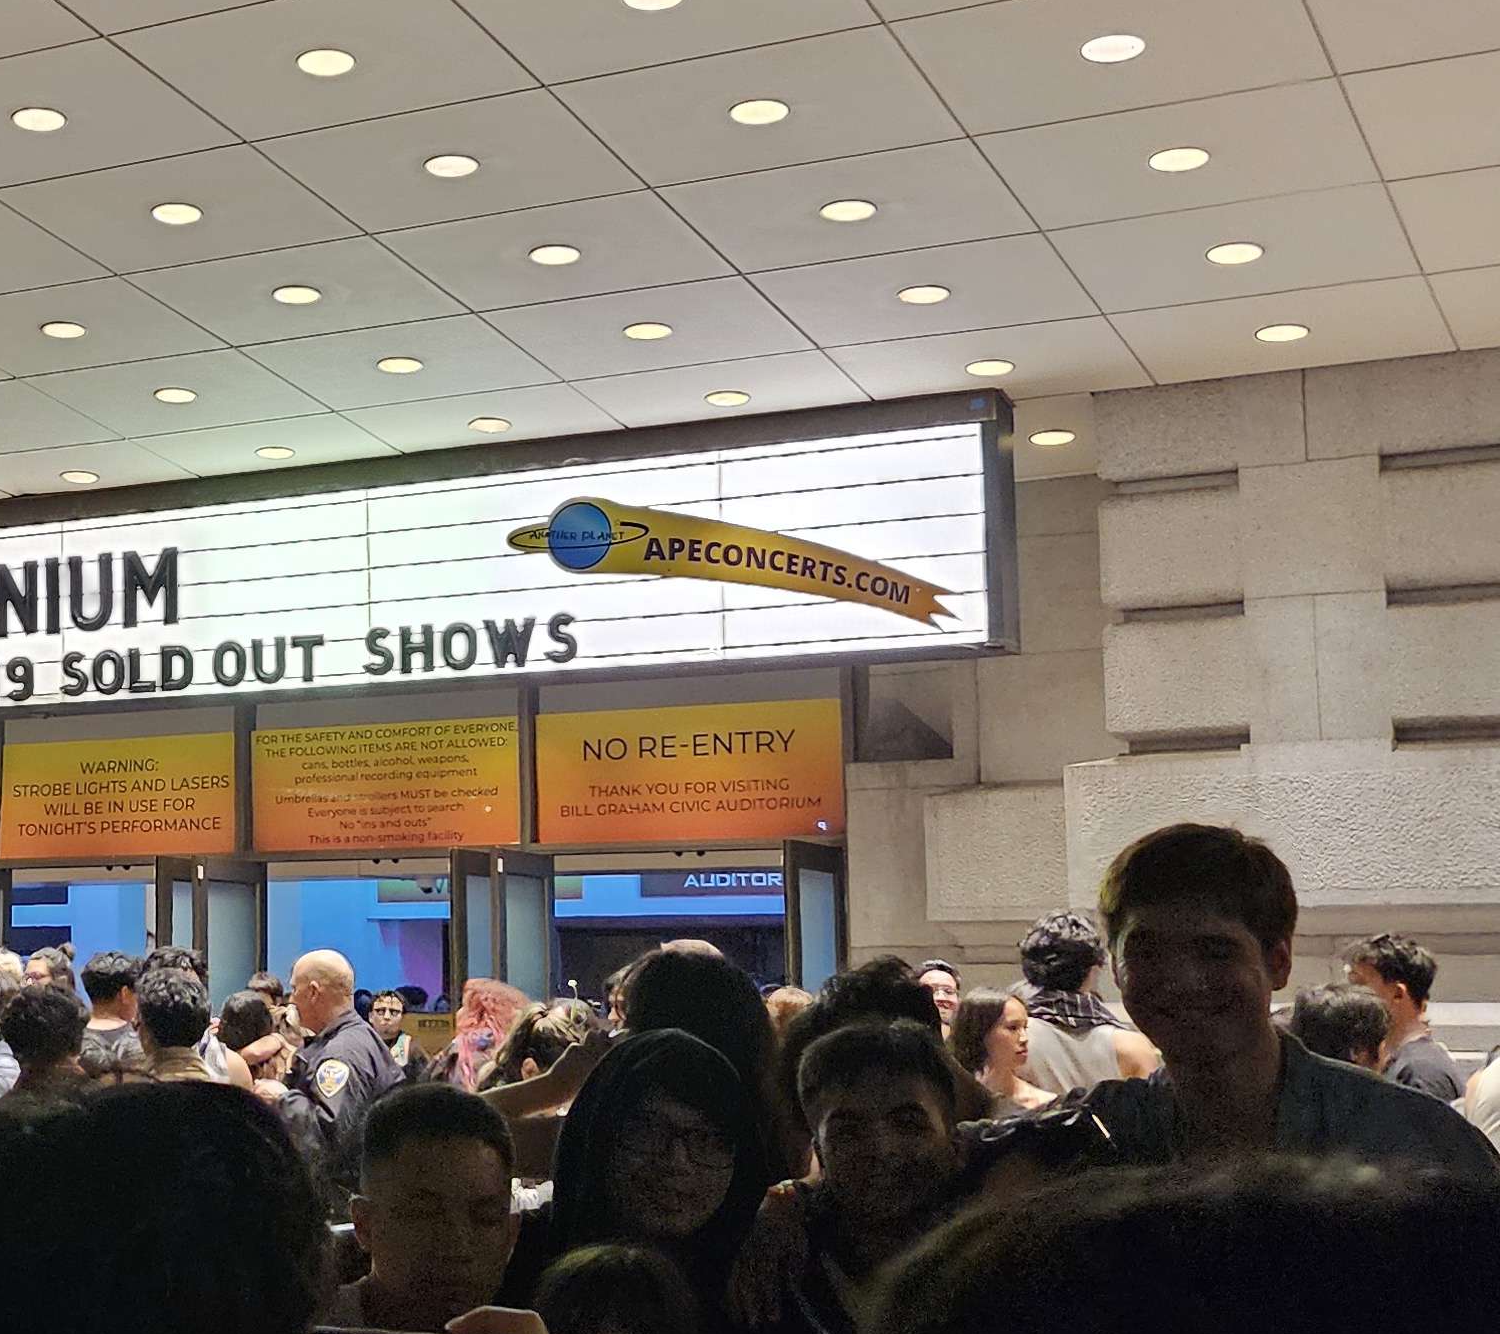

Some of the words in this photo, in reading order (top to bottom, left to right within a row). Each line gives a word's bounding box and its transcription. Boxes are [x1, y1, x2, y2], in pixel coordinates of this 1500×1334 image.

[581, 530, 625, 542] PLANET
[644, 537, 910, 604] APECONCERTS.COM
[60, 645, 194, 697] SOLD
[212, 633, 324, 687] OUT
[362, 613, 578, 676] SHOWS
[256, 735, 278, 745] FOR
[281, 733, 302, 743] THE
[305, 731, 346, 742] SAFETY
[348, 729, 372, 740] AND
[375, 727, 430, 739] COMFORT
[434, 725, 451, 736] OF
[583, 737, 628, 761] NO
[639, 729, 796, 758] RE-ENTRY
[265, 748, 287, 758] THE
[289, 744, 356, 757] FOLLOWING
[359, 742, 392, 753] ITEMS
[394, 740, 417, 751] ARE
[420, 739, 443, 750] NOT
[446, 736, 508, 748] ALLOWED:
[80, 758, 159, 774] WARNING:
[294, 772, 358, 785] professional
[360, 769, 413, 781] recording
[415, 767, 478, 780] equipment
[12, 782, 71, 798] STROBE
[75, 780, 127, 796] LIGHTS
[131, 778, 166, 793] AND
[171, 775, 230, 791] LASERS
[400, 788, 431, 799] MUST
[434, 788, 449, 799] be
[451, 785, 498, 797] checked
[589, 782, 642, 798] THANK
[645, 782, 680, 796] YOU
[684, 780, 717, 794] FOR
[720, 778, 790, 793] VISITING
[44, 802, 80, 816] WILL
[84, 801, 103, 815] BE
[108, 799, 124, 814] IN
[129, 798, 158, 813] USE
[164, 797, 195, 812] FOR
[308, 807, 357, 818] Everyone
[414, 804, 426, 813] to
[560, 803, 593, 818] BILL
[597, 801, 665, 816] GRAHAM
[669, 799, 711, 814] CIVIC
[715, 796, 822, 812] AUDITORIUM
[18, 821, 97, 837] TONIGHT'S
[100, 817, 221, 834] PERFORMANCE
[340, 820, 355, 829] No
[378, 818, 401, 828] and
[308, 834, 331, 844] This
